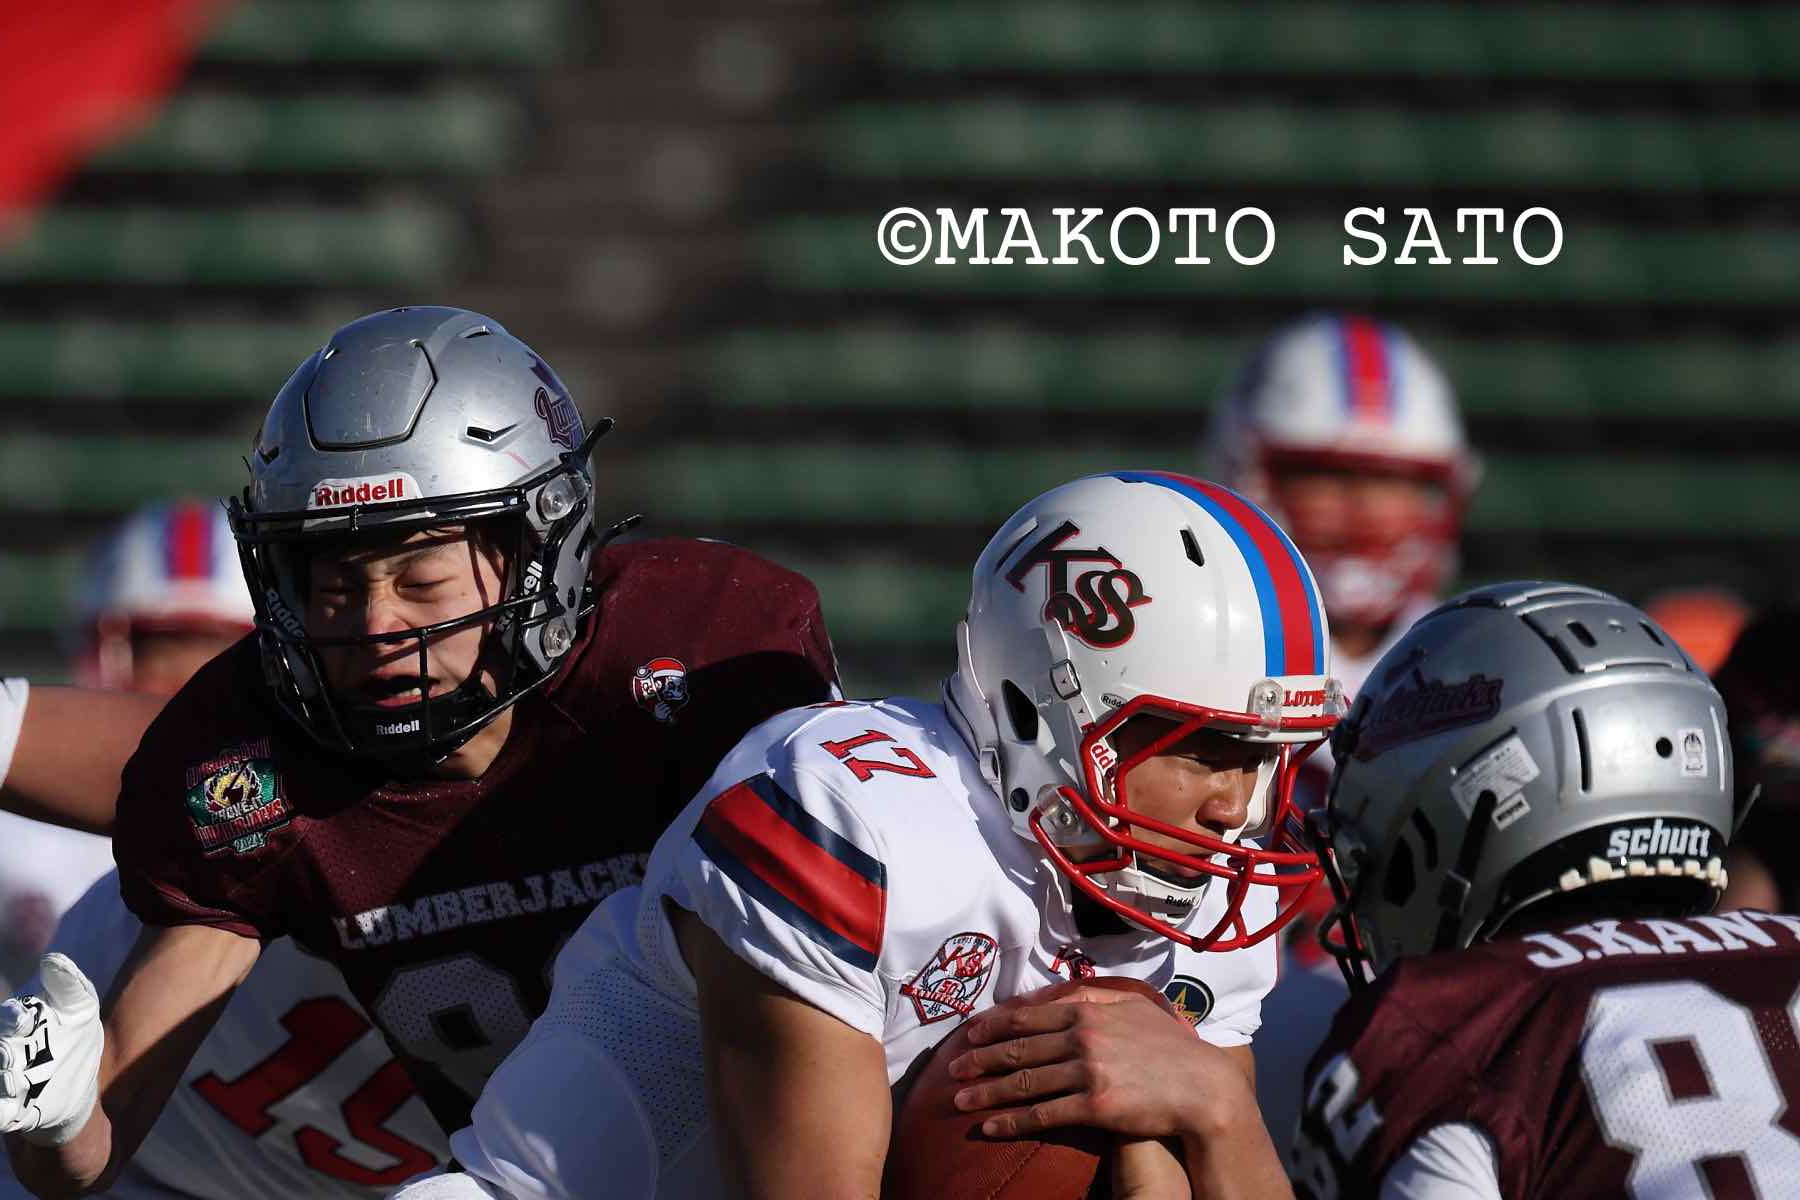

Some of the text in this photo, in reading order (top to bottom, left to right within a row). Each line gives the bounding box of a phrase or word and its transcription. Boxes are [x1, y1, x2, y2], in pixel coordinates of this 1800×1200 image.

[315, 478, 404, 506] Riddell
[376, 720, 421, 736] Riddell
[819, 729, 938, 783] 17
[1607, 819, 1710, 858] schutt
